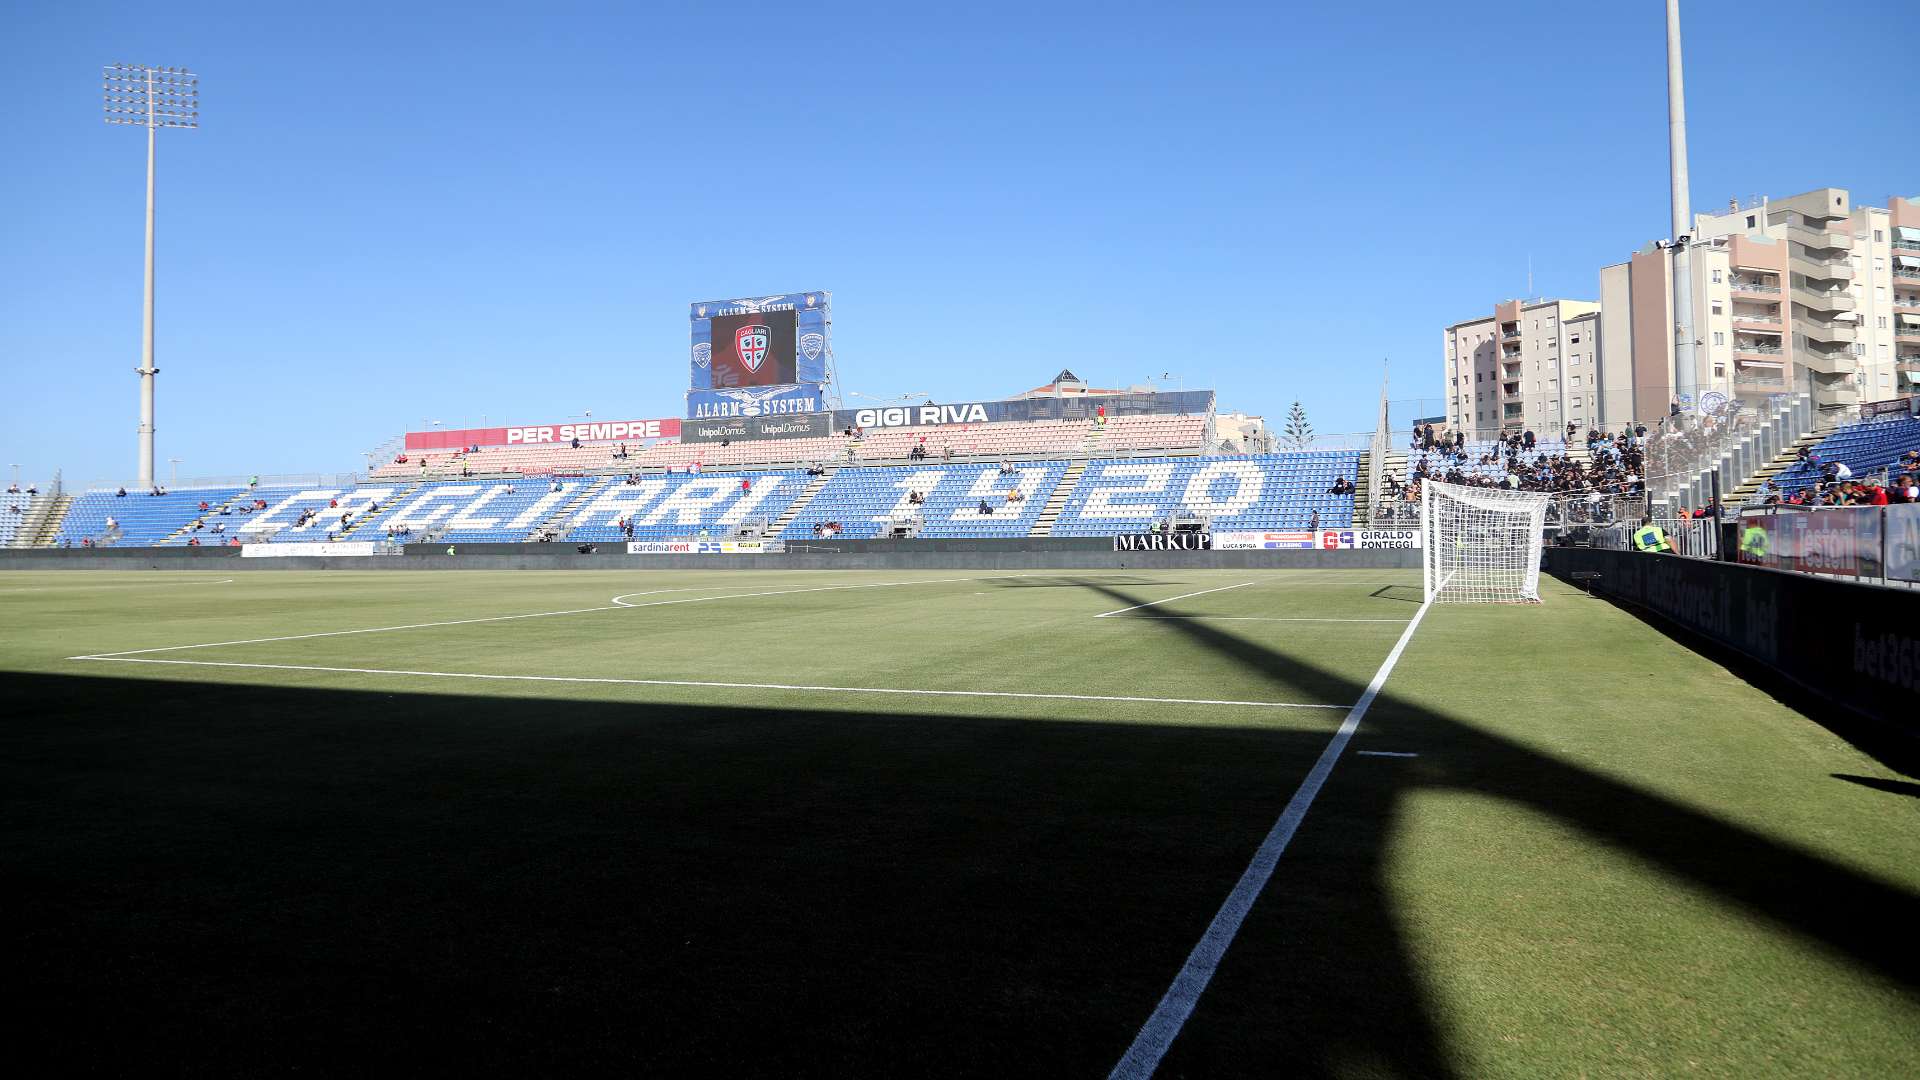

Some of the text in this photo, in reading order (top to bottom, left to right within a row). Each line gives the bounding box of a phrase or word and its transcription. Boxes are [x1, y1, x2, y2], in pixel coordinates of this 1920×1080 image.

[718, 303, 794, 317] ALARM SYSTEM
[740, 328, 767, 337] CAGLIARI
[696, 398, 815, 418] ALARM SYSTEM
[855, 403, 988, 428] GIGI RIVA
[507, 420, 661, 444] PER SEMPRE
[872, 459, 1266, 522] 1920
[240, 475, 784, 533] CAGLIARI
[1118, 533, 1210, 551] MARKUP
[1360, 531, 1414, 540] GIRALDO
[632, 542, 690, 552] sardiniarent
[1360, 541, 1414, 549] PONTEGGI
